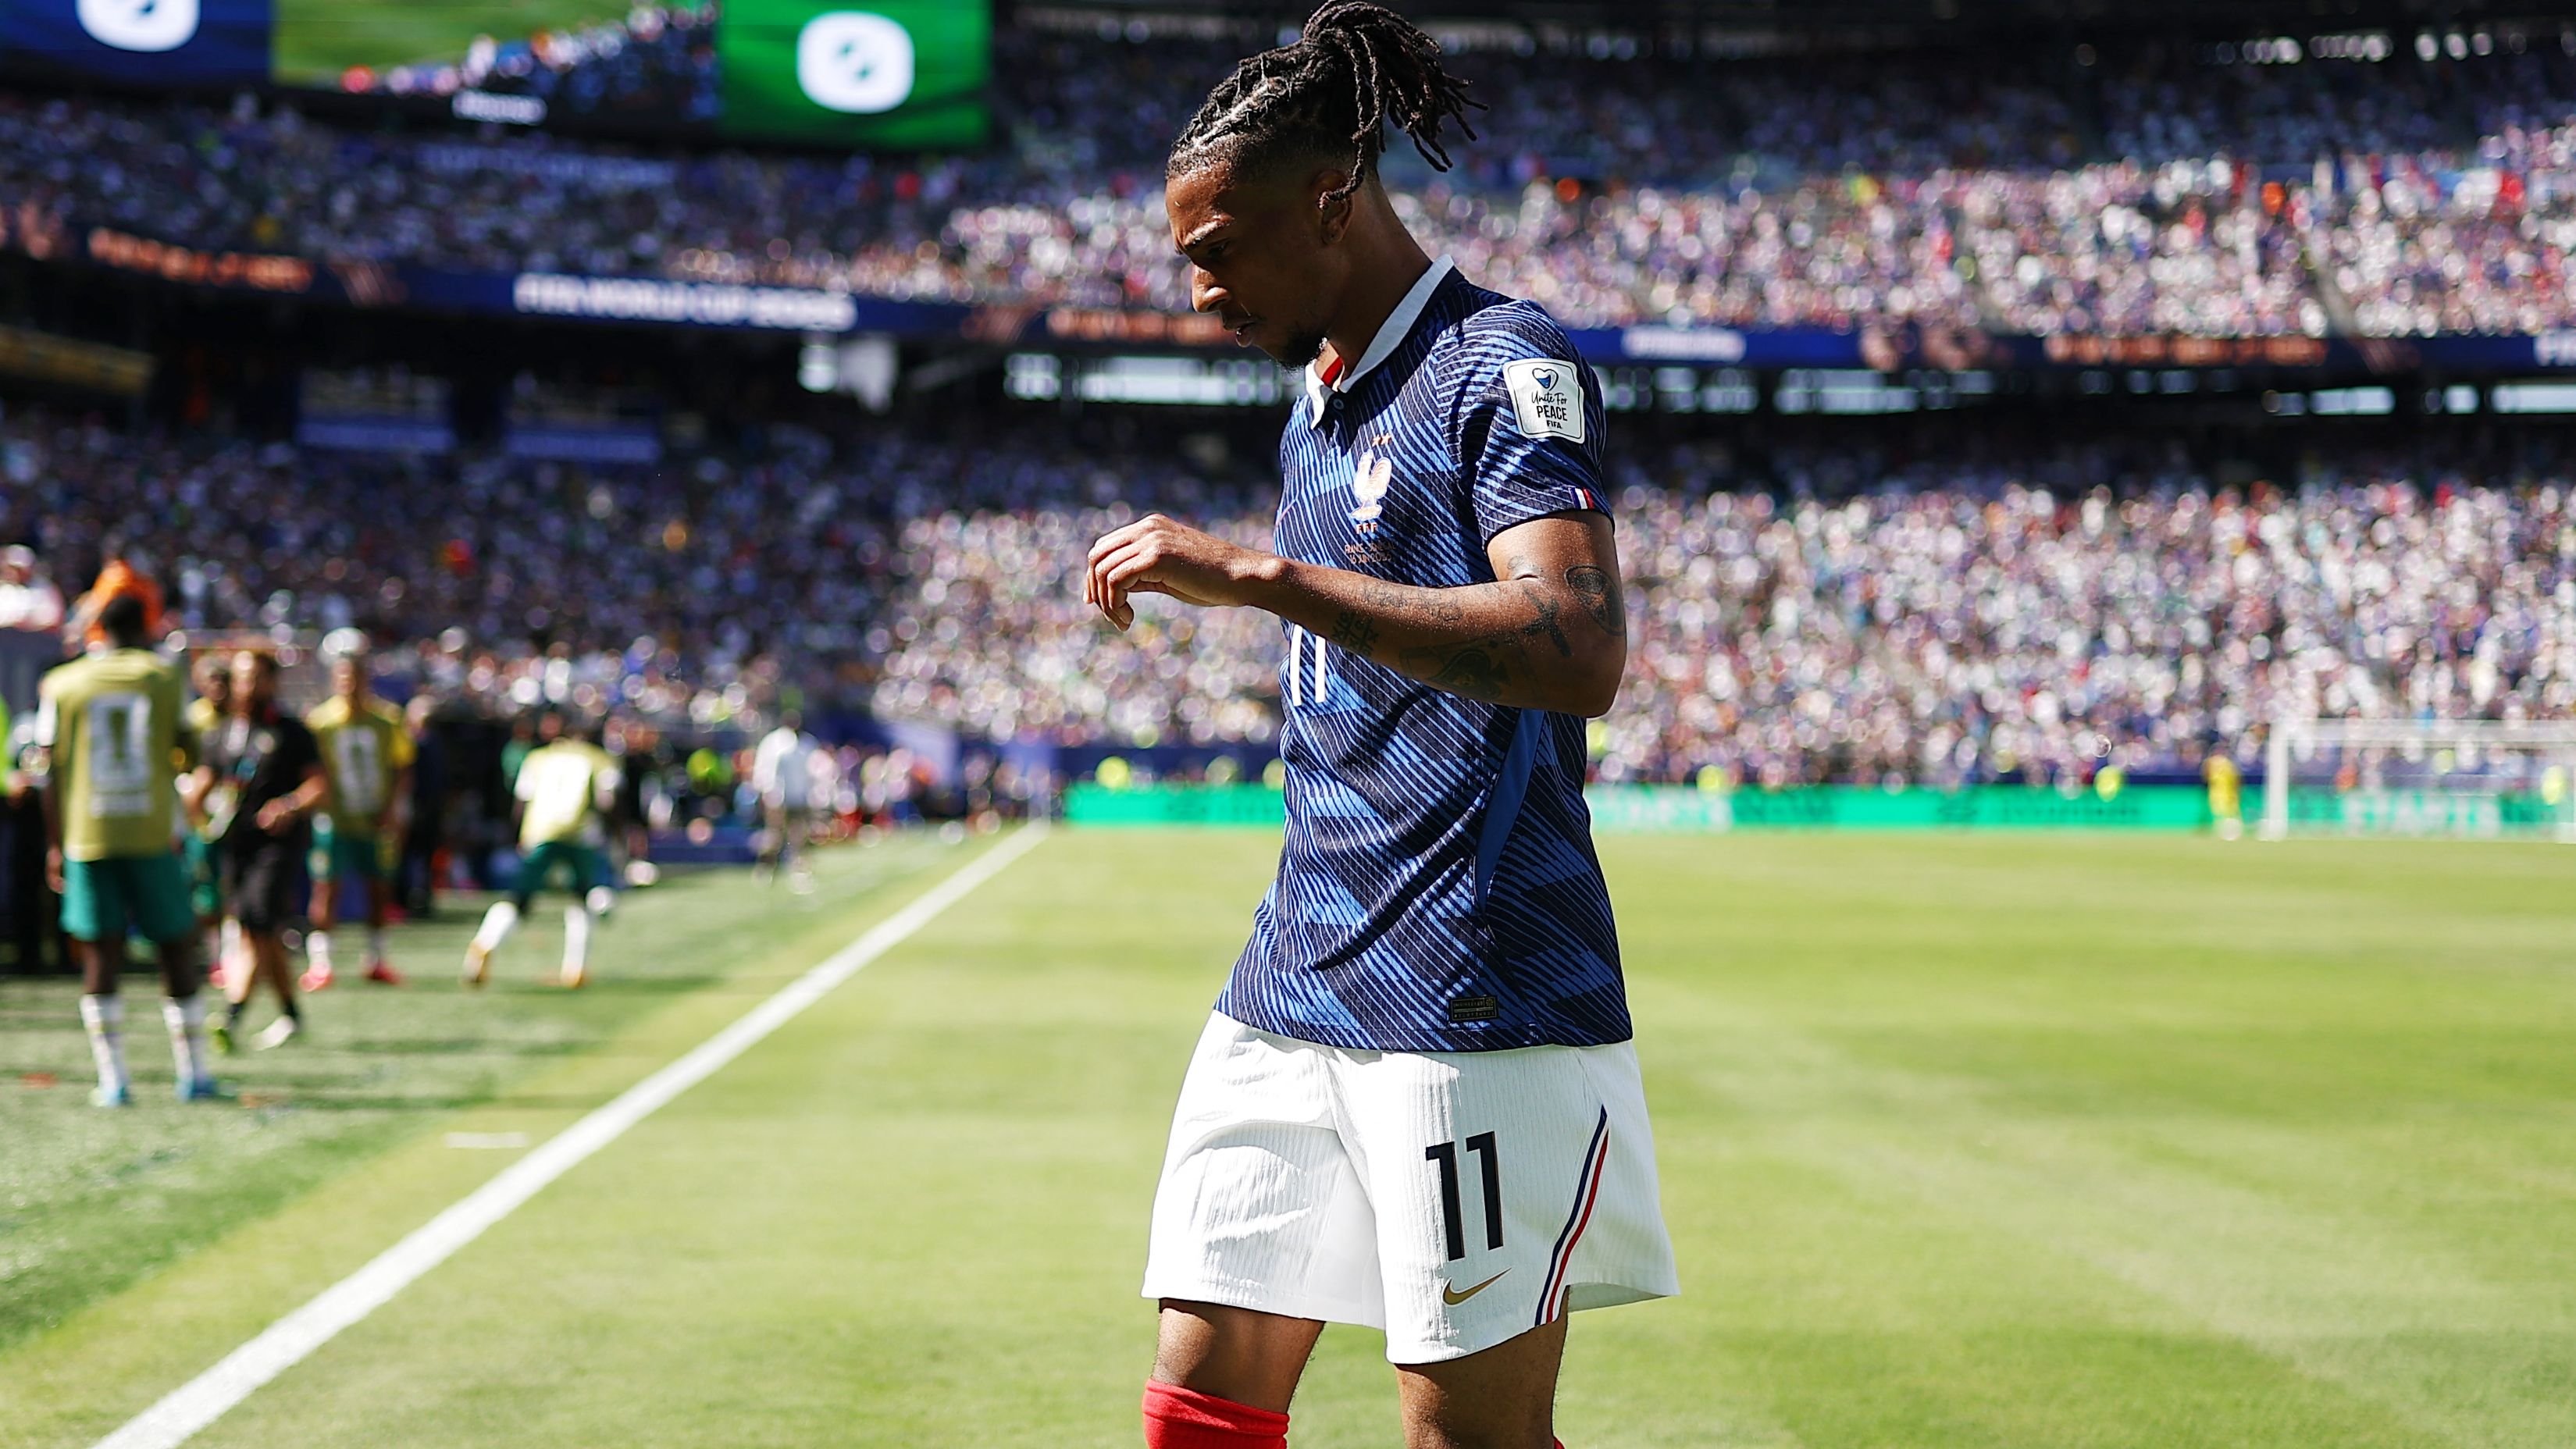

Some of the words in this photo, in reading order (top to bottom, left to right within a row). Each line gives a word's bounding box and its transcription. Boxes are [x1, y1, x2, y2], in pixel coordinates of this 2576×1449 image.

[1531, 390, 1555, 404] Unite
[1554, 392, 1567, 405] For
[1536, 404, 1568, 421] PEACE
[1546, 419, 1562, 429] FIFA
[1356, 522, 1377, 534] FFF
[1289, 623, 1327, 707] 11
[1425, 1131, 1504, 1262] 11
